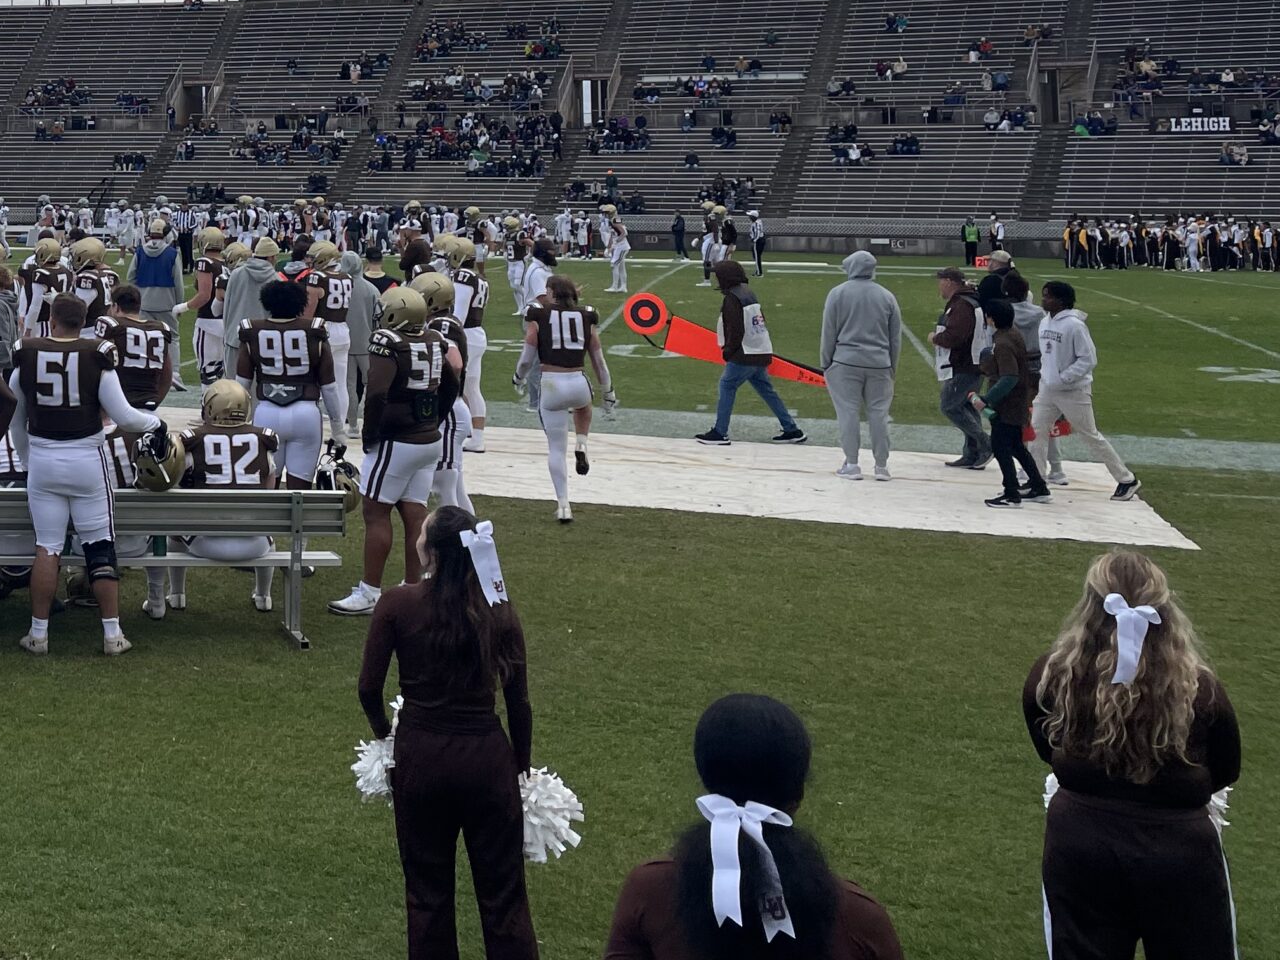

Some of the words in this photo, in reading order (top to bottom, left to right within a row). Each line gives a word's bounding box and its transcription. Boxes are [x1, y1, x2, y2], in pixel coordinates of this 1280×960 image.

[1169, 117, 1231, 132] LEHIGH
[890, 239, 904, 249] EC
[57, 273, 68, 293] 7
[80, 277, 93, 289] 66
[326, 278, 353, 310] 88
[548, 309, 585, 350] 10
[122, 326, 166, 370] 93
[257, 329, 310, 376] 99
[36, 350, 81, 407] 51
[203, 433, 261, 485] 92
